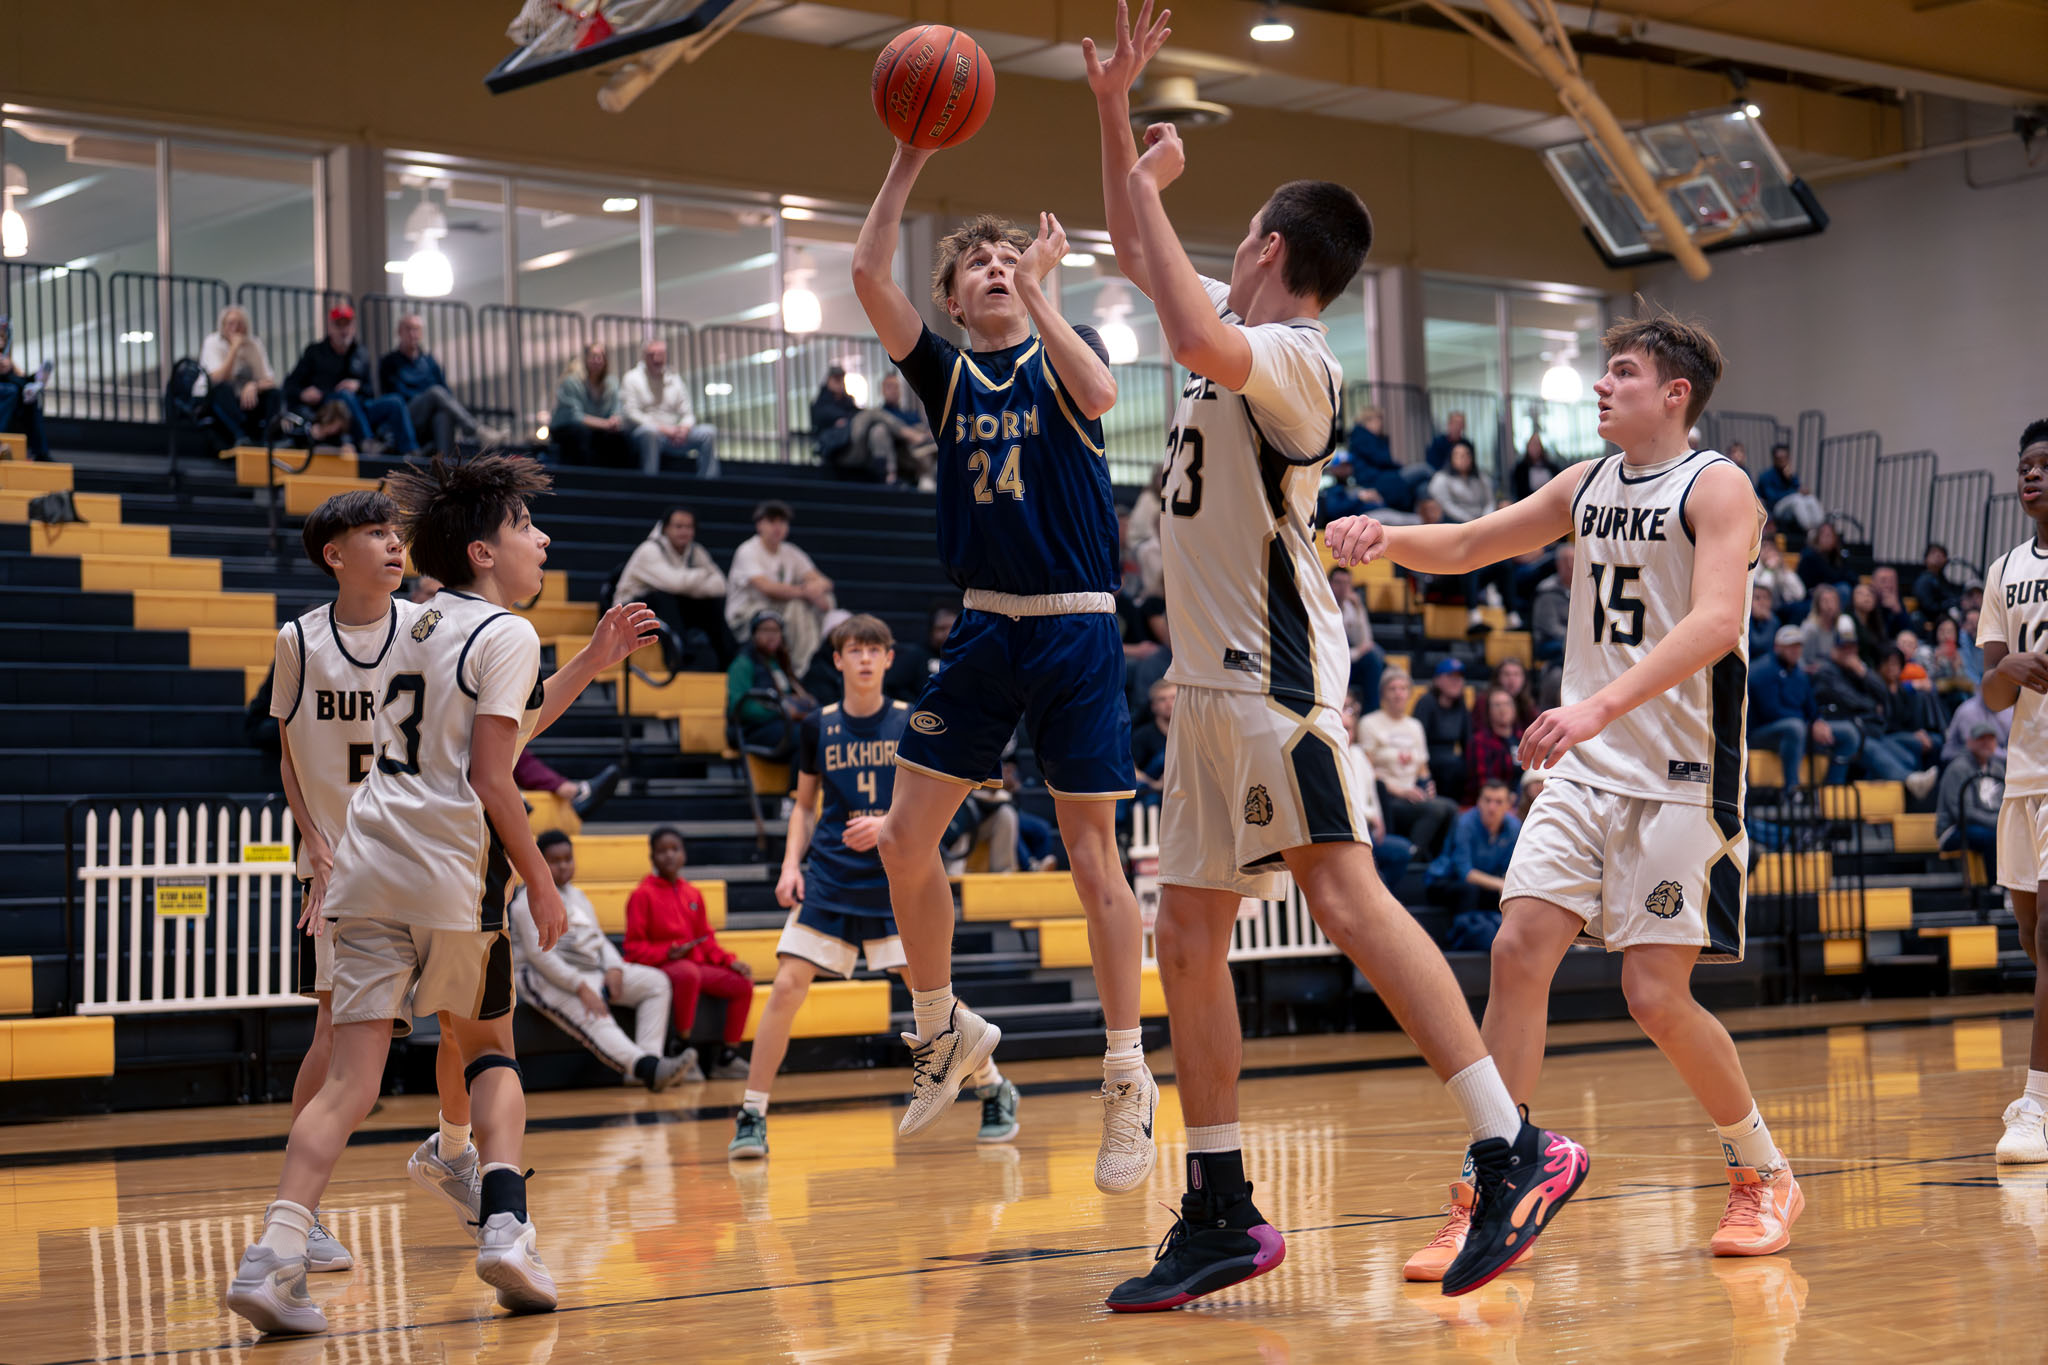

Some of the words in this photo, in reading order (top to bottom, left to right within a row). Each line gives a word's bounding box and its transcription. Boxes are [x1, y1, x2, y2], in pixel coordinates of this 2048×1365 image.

[889, 43, 935, 123] Baden
[929, 84, 963, 137] ELITE
[955, 405, 1040, 444] STORM
[967, 445, 1025, 505] 24
[1161, 424, 1205, 520] 23
[1580, 504, 1671, 541] BURKE
[1587, 560, 1647, 648] 15
[2005, 578, 2048, 610] BUR
[315, 688, 376, 722] BUR
[376, 670, 427, 777] 3
[825, 739, 899, 772] ELKHOR
[857, 770, 877, 804] 4
